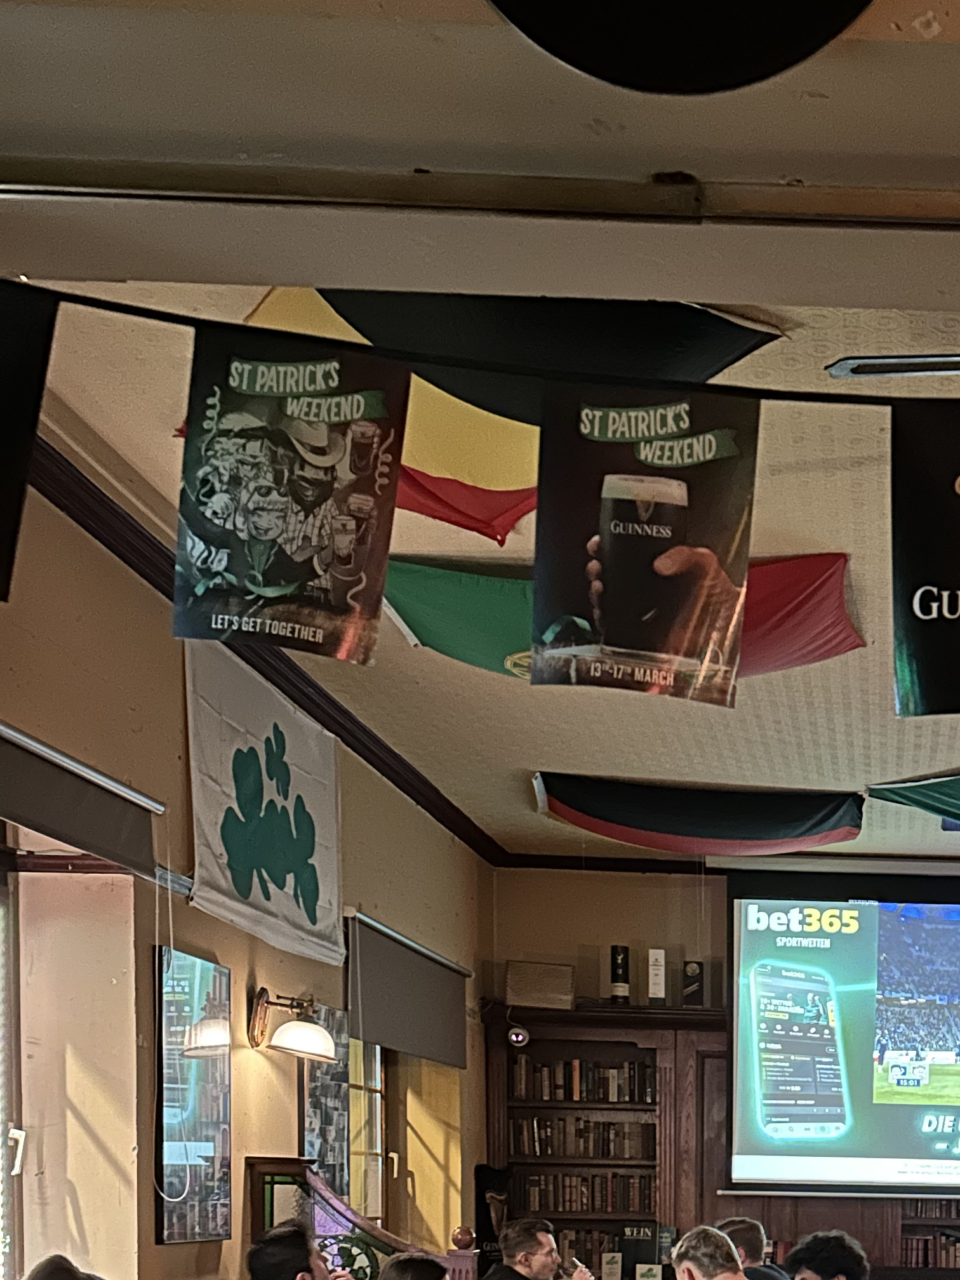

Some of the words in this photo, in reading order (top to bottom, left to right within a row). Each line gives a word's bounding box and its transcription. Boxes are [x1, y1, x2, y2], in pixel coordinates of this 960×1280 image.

[229, 361, 252, 390] ST
[255, 361, 340, 393] PATRICK'S
[286, 394, 365, 422] WEEKEND
[580, 408, 603, 437] ST
[607, 403, 690, 438] PATRICK'S
[640, 434, 717, 465] WEEKEND
[610, 520, 672, 538] GUINNESS
[211, 614, 239, 630] LET'S
[241, 617, 261, 633] GET
[265, 619, 324, 643] TOGETHER
[634, 667, 675, 686] MARCH
[747, 904, 859, 934] bet365
[776, 937, 831, 948] SPORTWETTEN
[922, 1115, 955, 1133] DIE
[624, 1227, 652, 1237] WEIN
